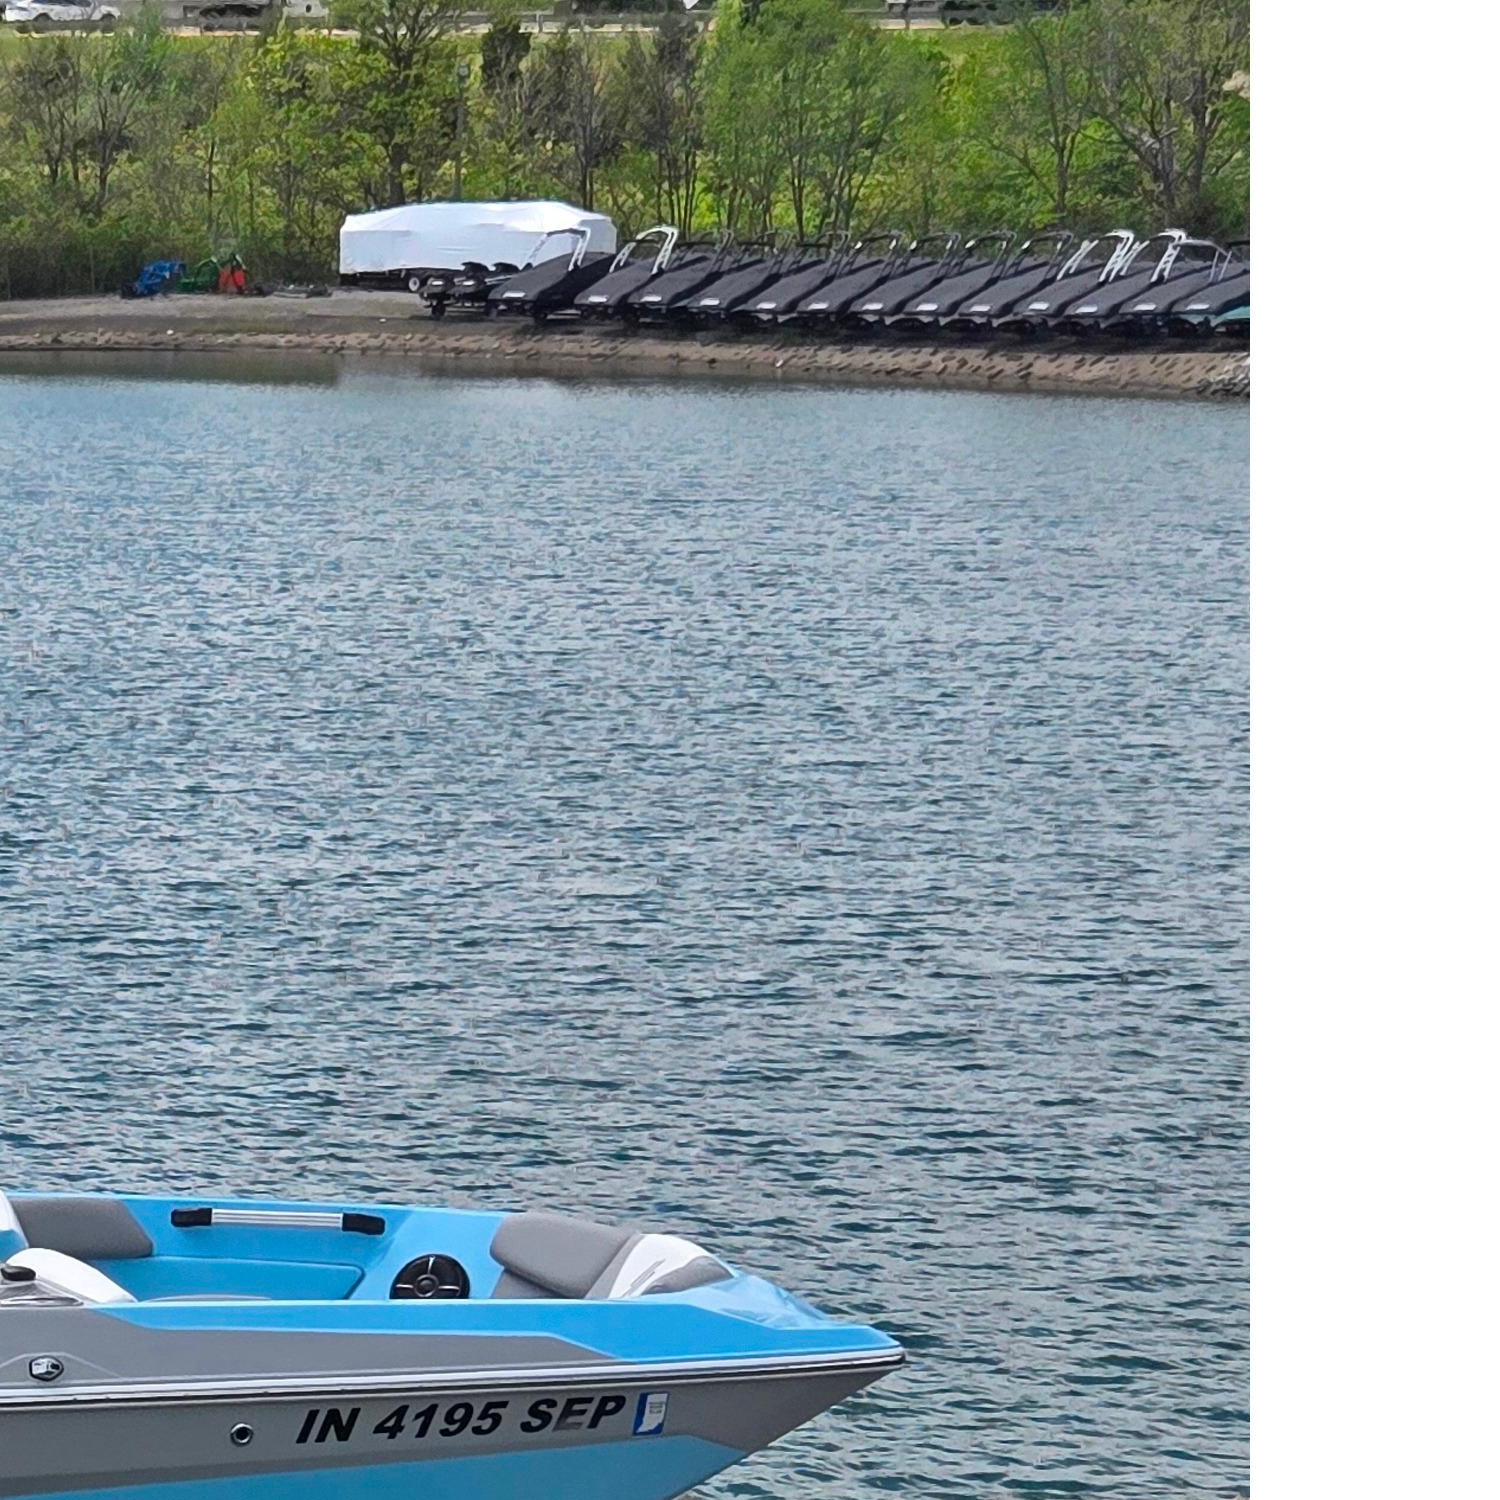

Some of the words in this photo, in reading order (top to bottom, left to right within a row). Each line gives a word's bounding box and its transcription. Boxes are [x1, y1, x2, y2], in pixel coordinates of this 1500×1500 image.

[296, 1407, 361, 1444] IN
[373, 1400, 508, 1440] 4195
[520, 1394, 626, 1433] SEP
